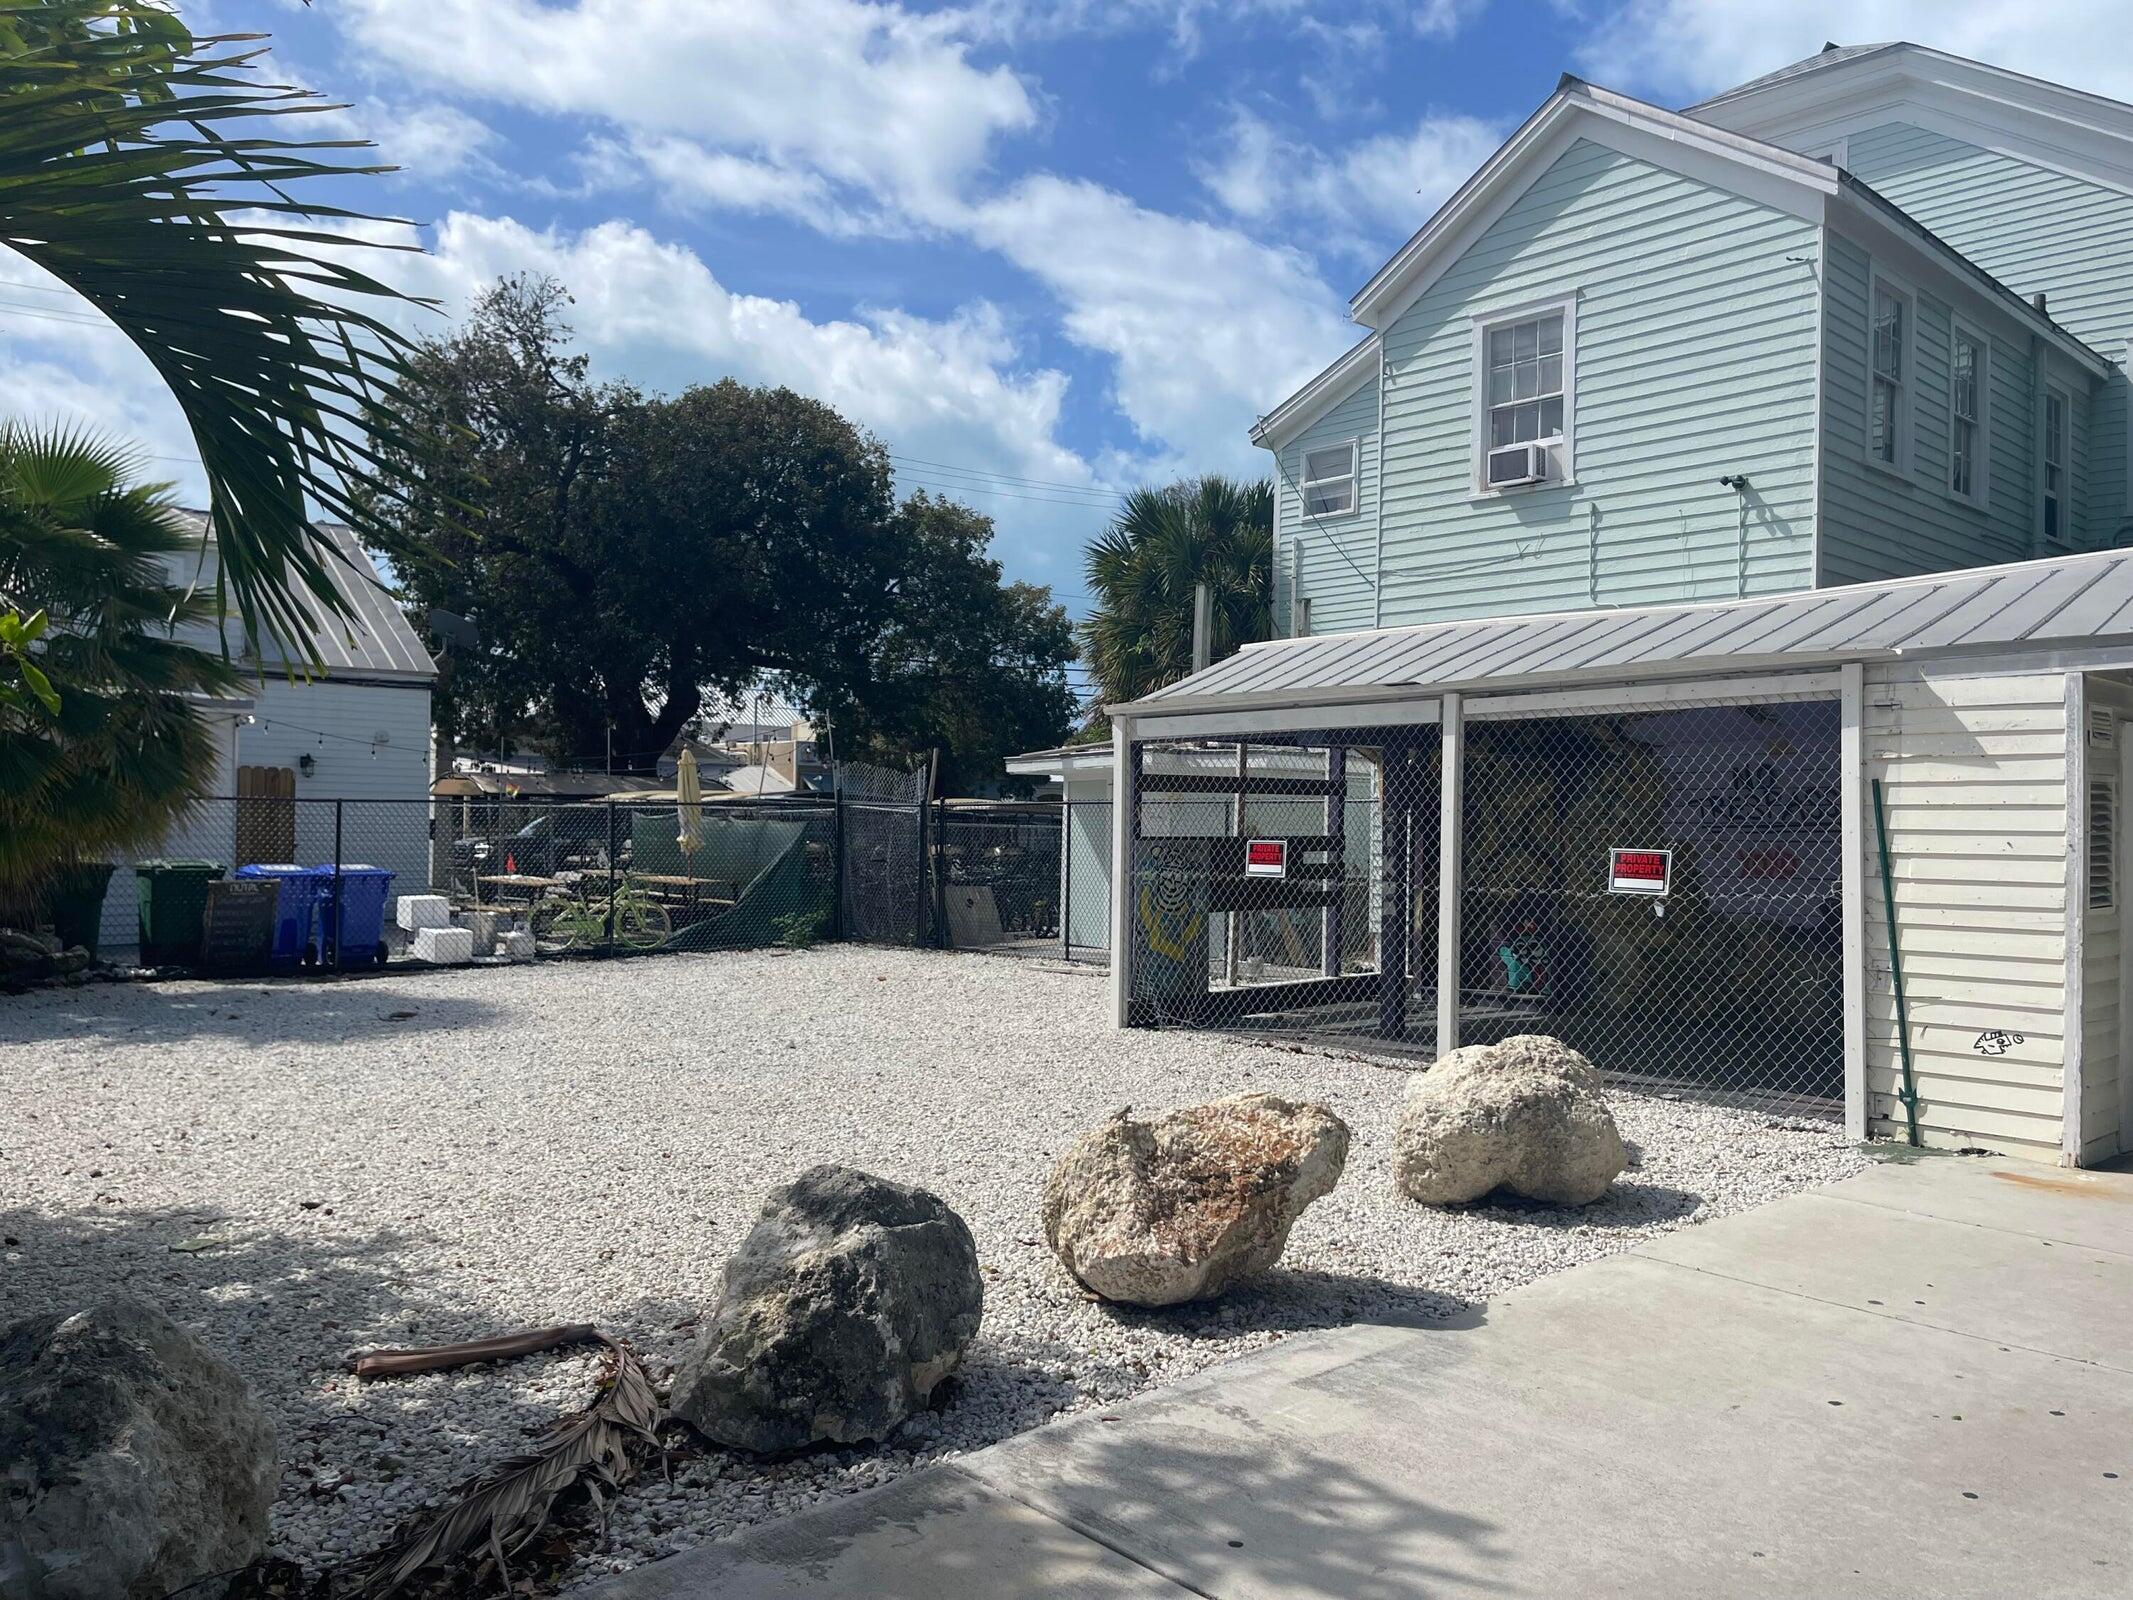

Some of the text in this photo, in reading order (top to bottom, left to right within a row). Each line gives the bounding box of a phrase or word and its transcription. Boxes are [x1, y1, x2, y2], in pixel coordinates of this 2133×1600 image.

[1252, 845, 1280, 853] PRIVATE
[1249, 852, 1282, 861] PROPERTY
[1620, 853, 1661, 864] PRIVATE
[1615, 863, 1665, 874] PROPERTY
